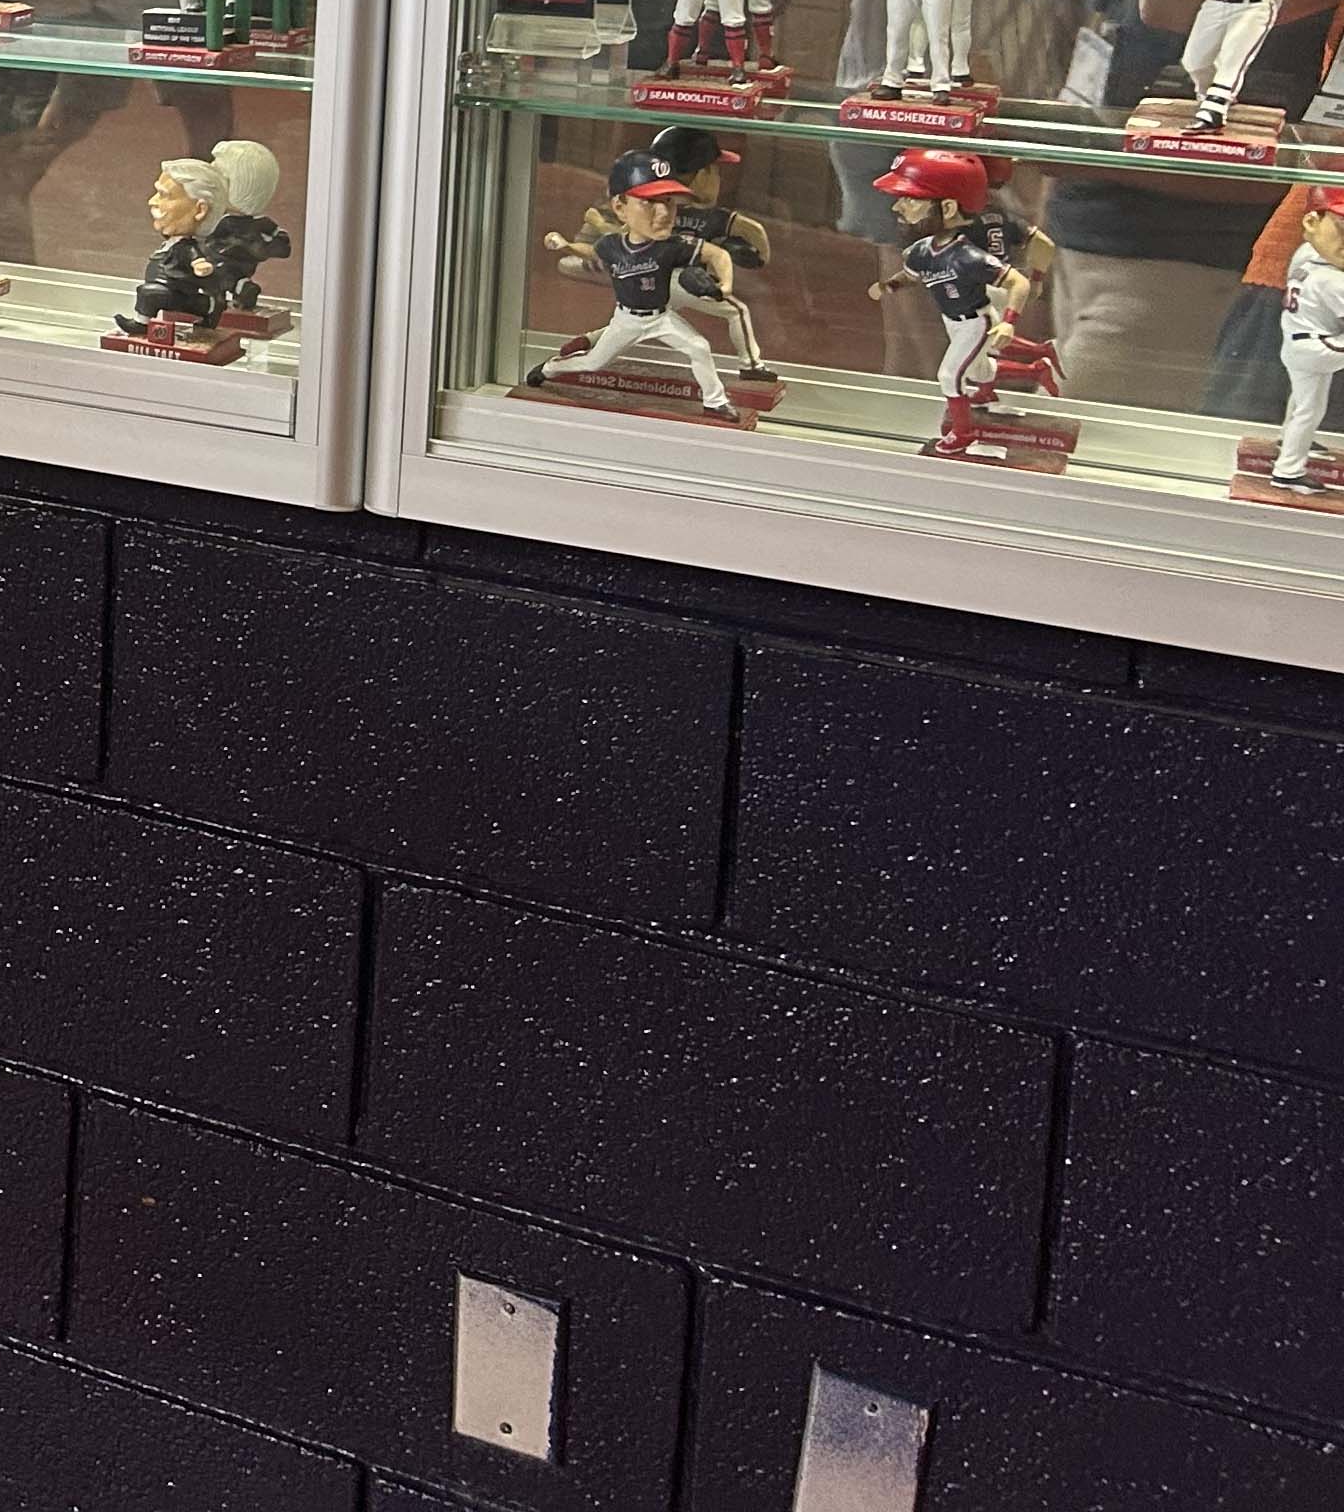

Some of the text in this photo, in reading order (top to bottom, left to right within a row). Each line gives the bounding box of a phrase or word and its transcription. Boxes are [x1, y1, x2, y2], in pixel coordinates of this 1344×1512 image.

[649, 91, 729, 106] SEAN DOOLITTLE
[862, 108, 946, 126] MAX SCHERZER
[1153, 139, 1246, 157] RYAN ZIMMERMAN
